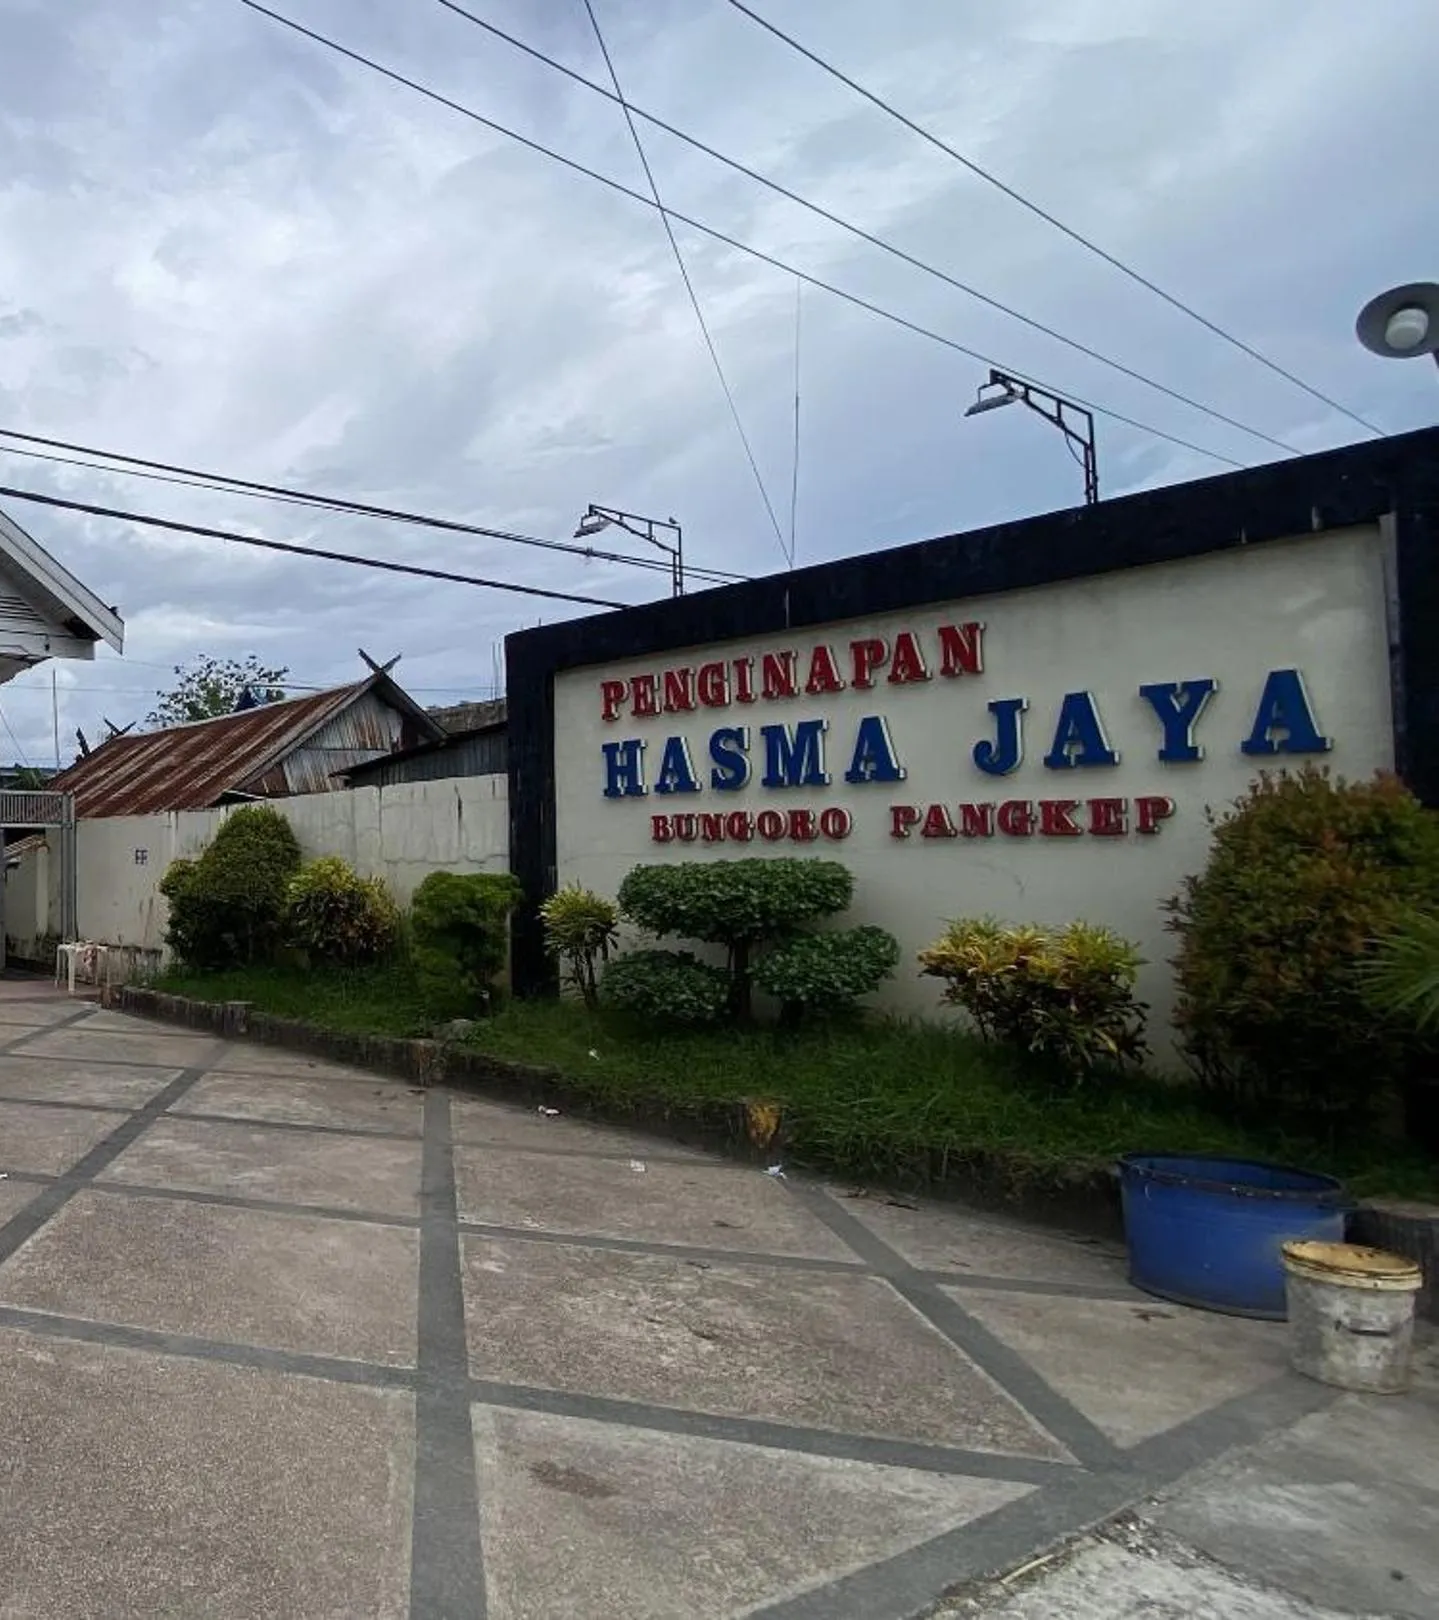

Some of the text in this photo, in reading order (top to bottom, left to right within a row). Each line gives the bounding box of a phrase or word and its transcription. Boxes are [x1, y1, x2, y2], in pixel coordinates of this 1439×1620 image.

[601, 623, 985, 720] PENGINAPAN
[602, 669, 1332, 797] HASMA JAYA
[652, 796, 1175, 842] BUNGORO PANGKEP
